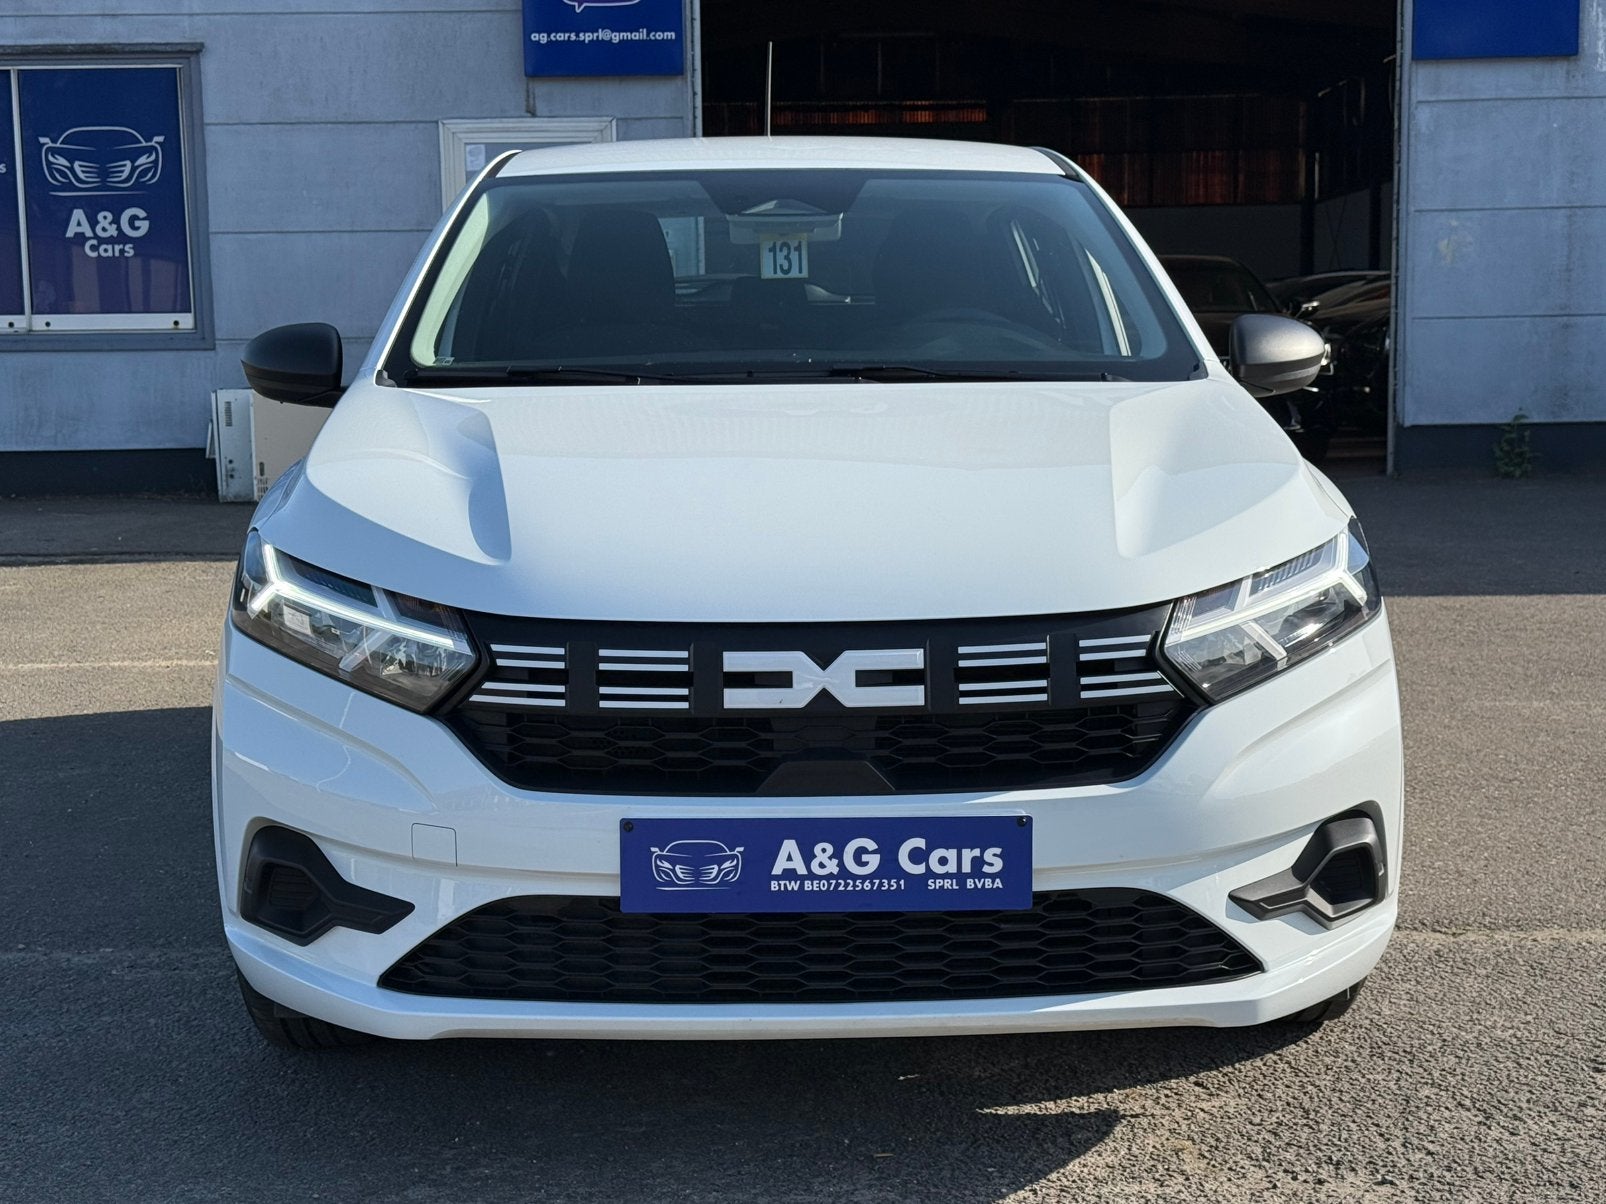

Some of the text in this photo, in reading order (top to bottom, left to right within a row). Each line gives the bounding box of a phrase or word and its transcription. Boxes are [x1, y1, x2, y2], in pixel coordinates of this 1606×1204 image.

[530, 28, 676, 44] ag.cars.sprl@gmail.com
[65, 207, 150, 238] A&G
[84, 239, 135, 258] Cars
[768, 241, 804, 276] 131
[770, 837, 1004, 876] A&G Cars
[770, 878, 1003, 892] BTW BE0722567351 SPRL BVBA
